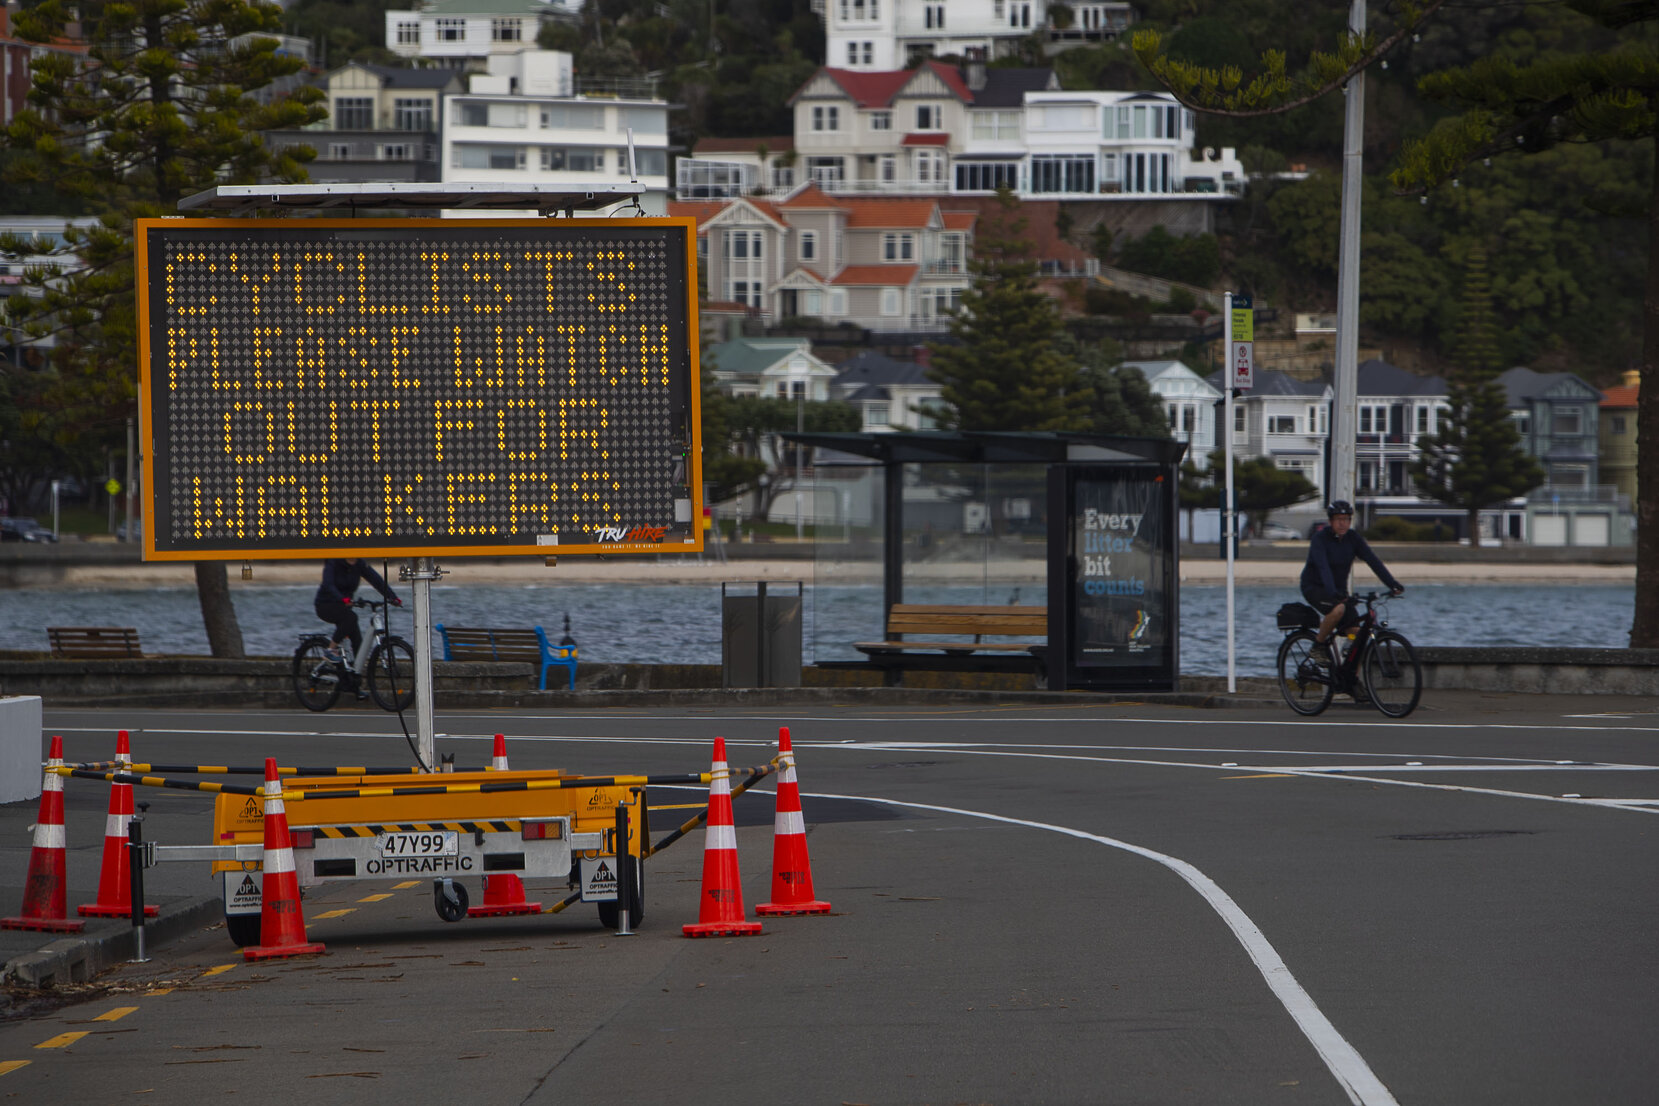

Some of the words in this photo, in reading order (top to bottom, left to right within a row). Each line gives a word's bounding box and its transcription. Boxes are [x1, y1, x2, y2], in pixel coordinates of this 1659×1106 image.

[166, 251, 637, 316] CYCLISTS
[168, 325, 421, 391] PLEASE
[453, 324, 669, 388] WATCH
[223, 399, 401, 465] OUT
[434, 397, 609, 462] FOR
[192, 471, 622, 540] WALKERS
[1085, 508, 1143, 536] Every
[595, 527, 627, 543] TRU
[1084, 532, 1134, 554] litter
[1084, 555, 1112, 577] bit
[1084, 576, 1145, 596] counts
[385, 835, 444, 854] 47Y99
[366, 856, 473, 874] OPTRAFFIC
[594, 870, 612, 881] OPT
[239, 884, 256, 895] OPT
